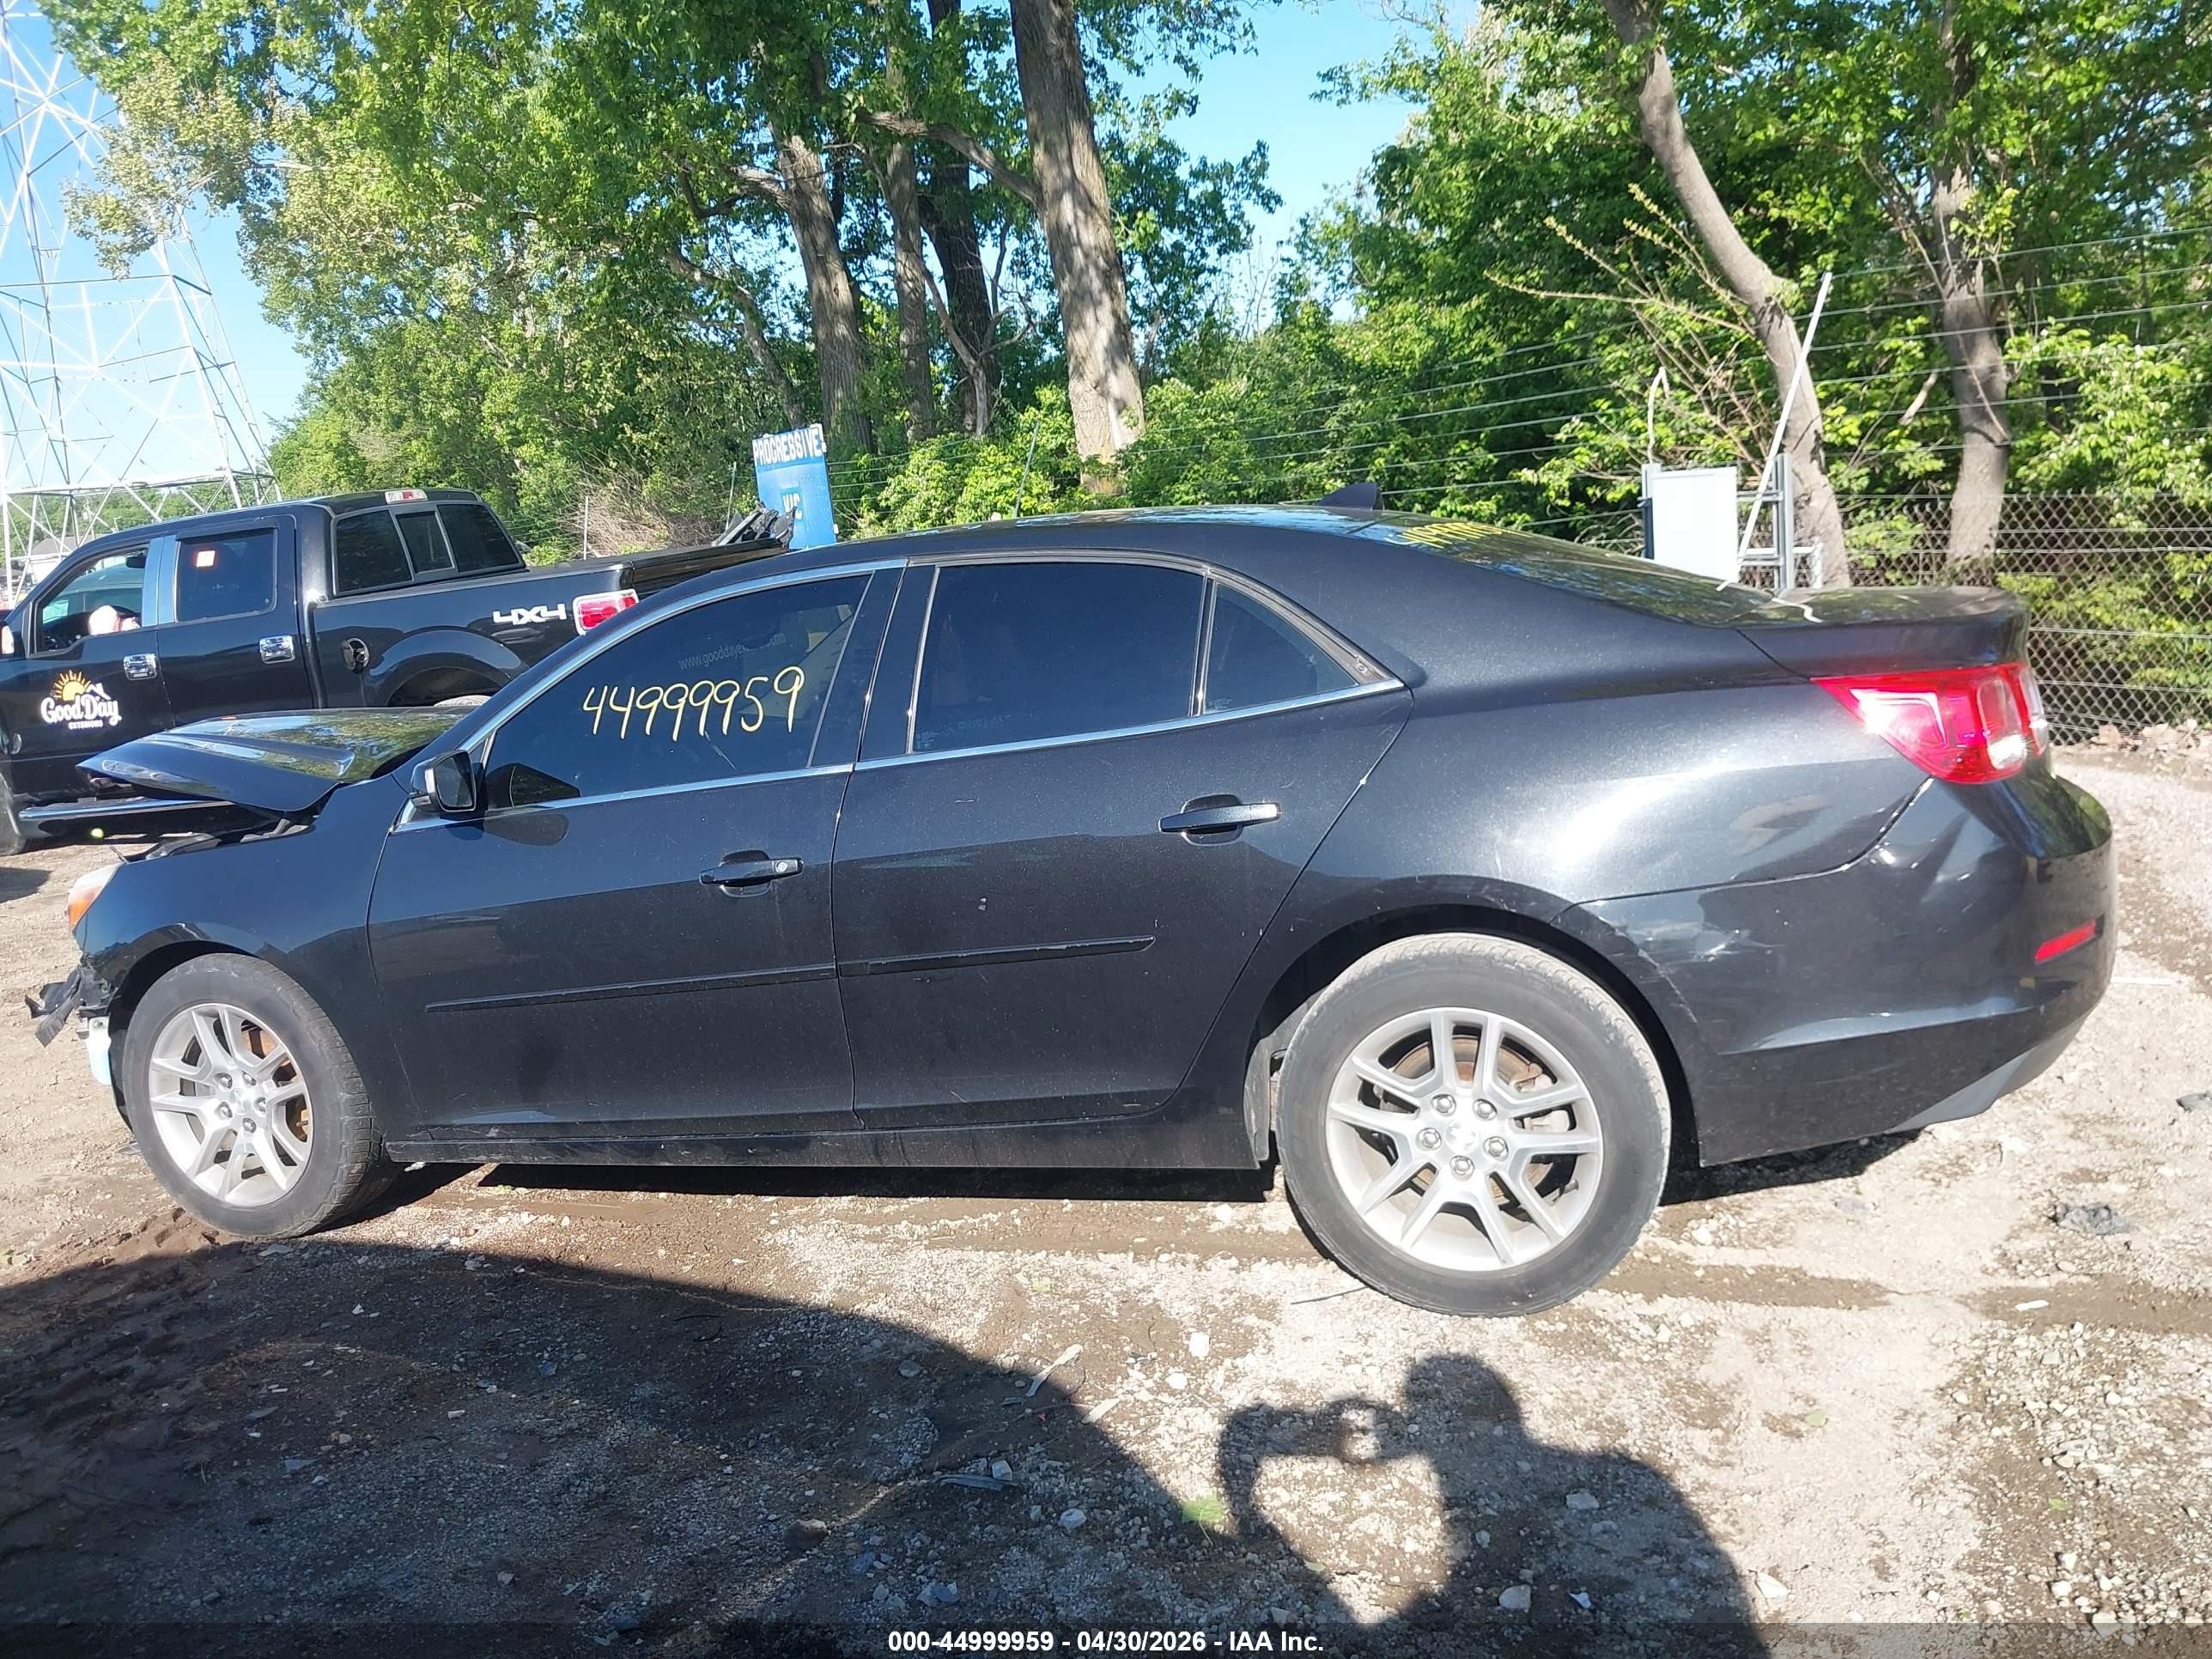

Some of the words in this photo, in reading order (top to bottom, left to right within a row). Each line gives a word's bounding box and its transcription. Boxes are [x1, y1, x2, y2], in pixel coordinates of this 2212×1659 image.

[752, 428, 823, 467] PROGRESSIVE
[493, 604, 567, 625] 4X4
[40, 695, 83, 724] Good
[80, 694, 122, 726] Day
[582, 665, 805, 742] 44999959
